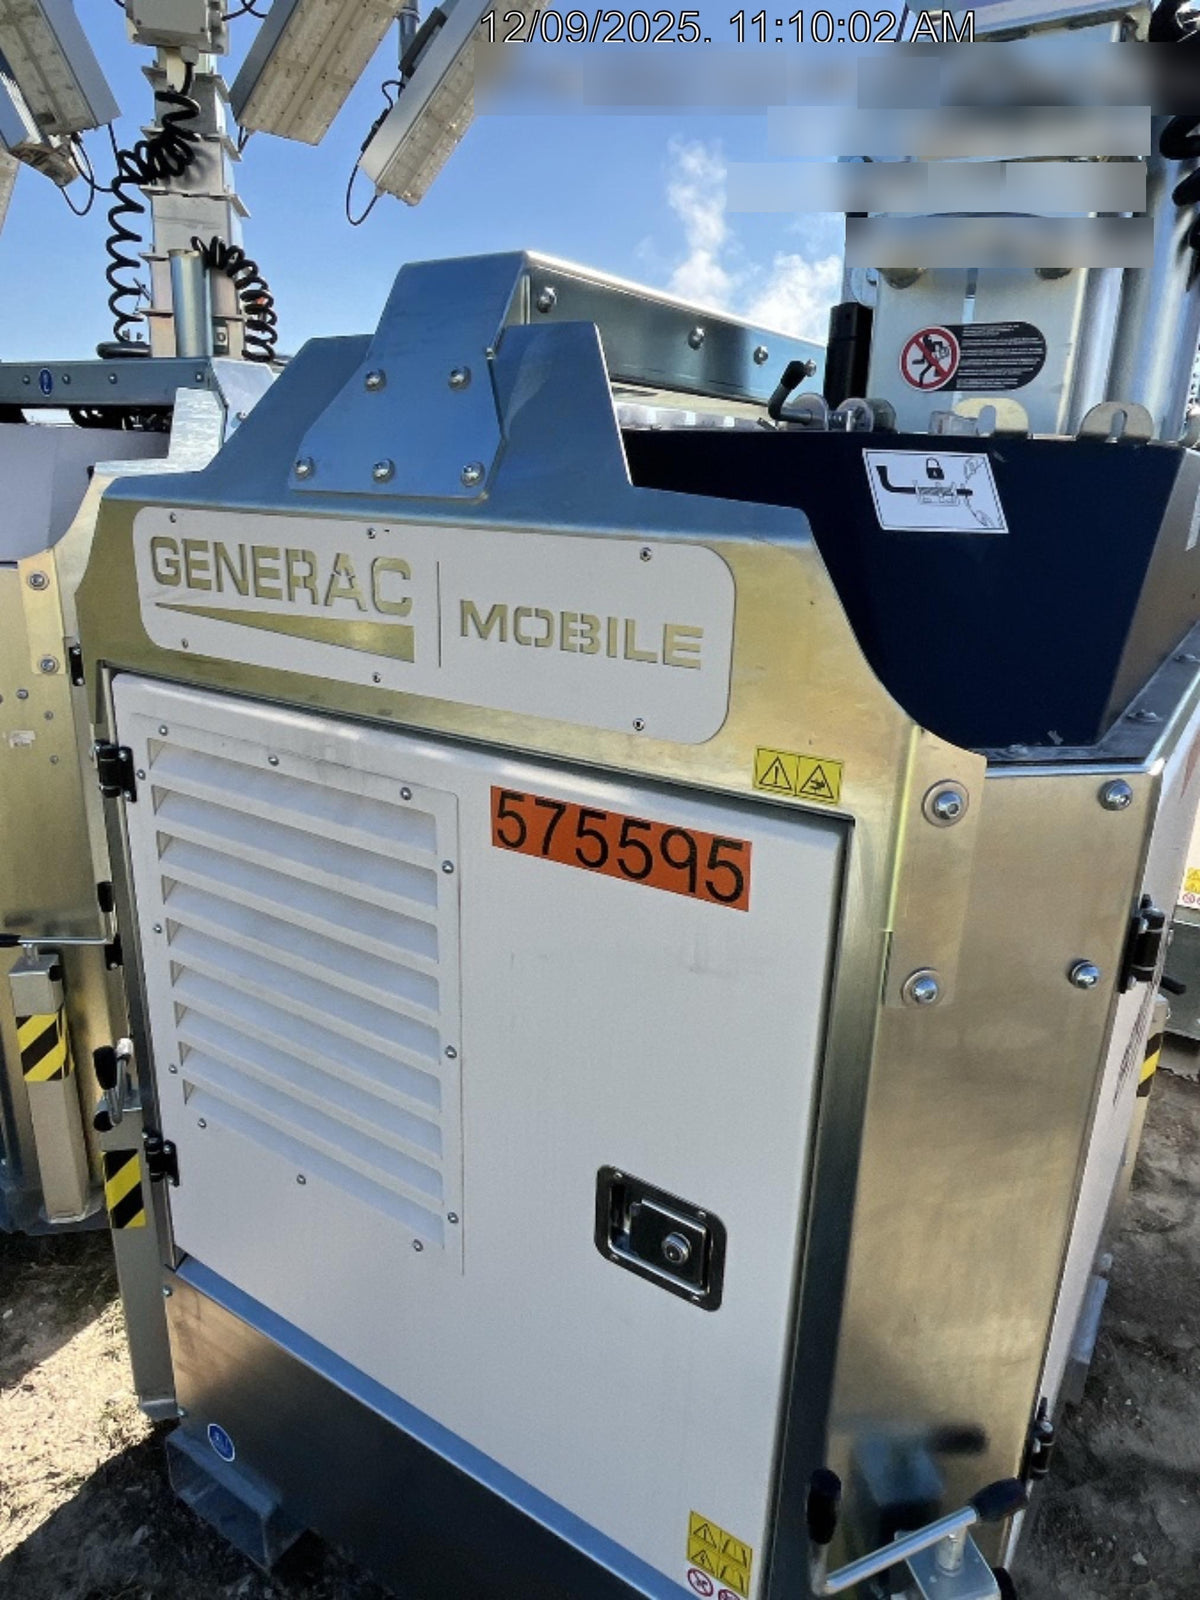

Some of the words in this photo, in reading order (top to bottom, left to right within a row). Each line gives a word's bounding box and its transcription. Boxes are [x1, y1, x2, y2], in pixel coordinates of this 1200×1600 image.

[150, 536, 414, 618] GENERAC
[459, 599, 705, 671] MOBILE
[497, 790, 744, 903] 575595
